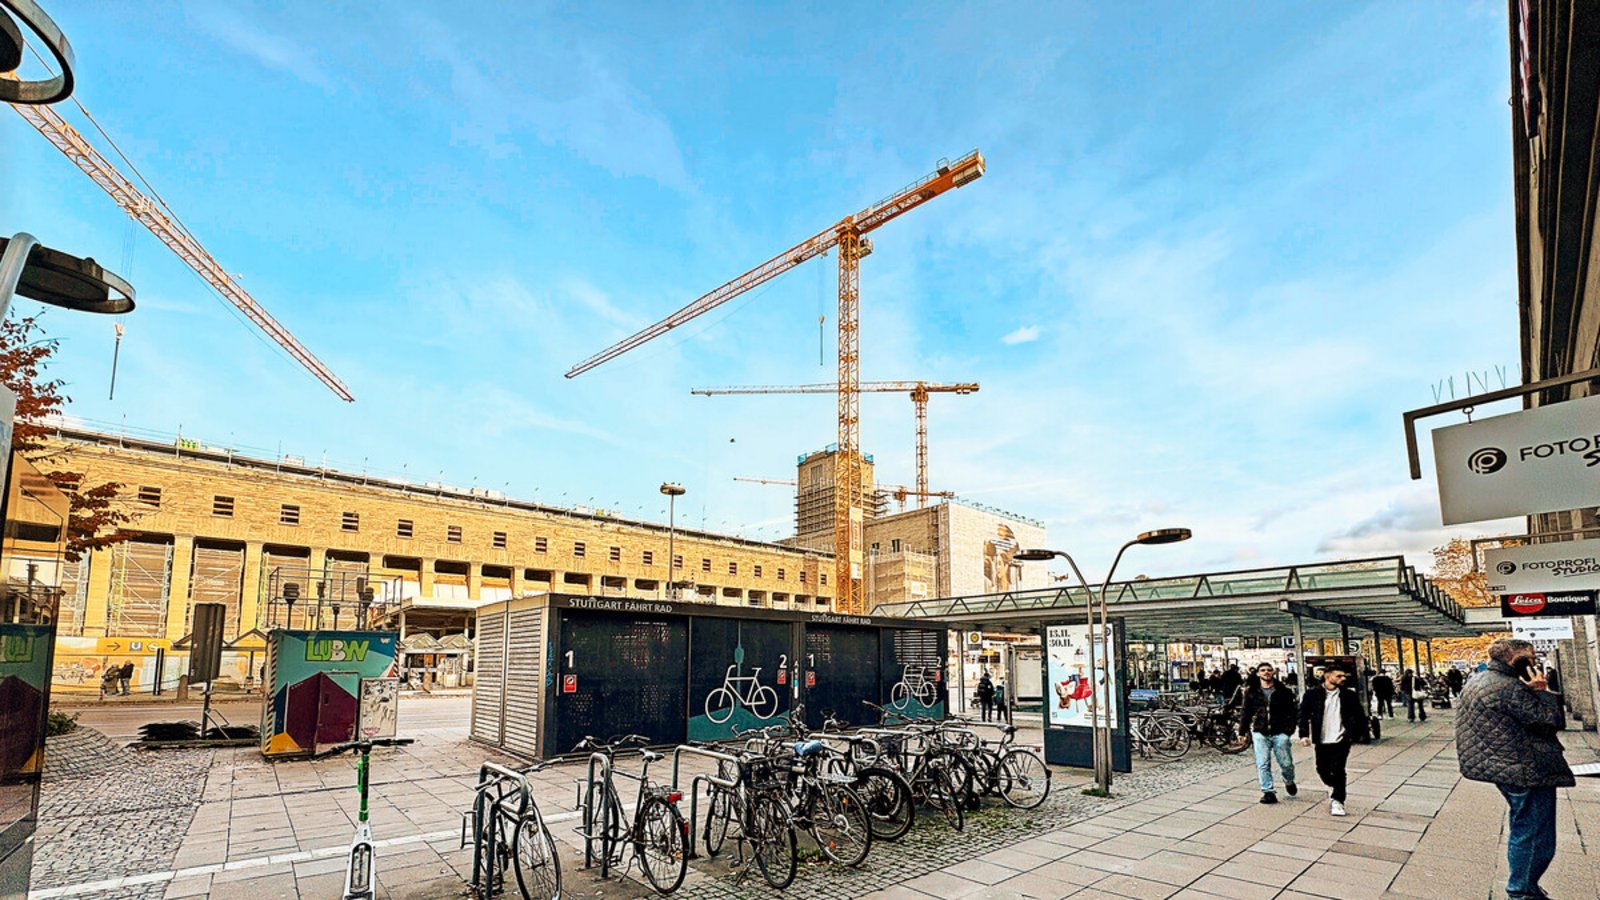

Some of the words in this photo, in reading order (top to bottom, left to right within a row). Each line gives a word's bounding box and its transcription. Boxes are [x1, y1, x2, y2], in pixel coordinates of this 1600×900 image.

[1522, 557, 1596, 571] FOTOPROFI
[569, 597, 622, 611] STUTTGART
[624, 602, 653, 613] FÄHRT
[654, 603, 673, 614] RAD
[1509, 594, 1545, 606] Leica
[1546, 595, 1590, 605] Boutique
[306, 639, 369, 661] LUBW
[565, 650, 574, 668] 1
[779, 654, 788, 669] 2
[807, 653, 815, 668] 1
[936, 656, 942, 668] 2
